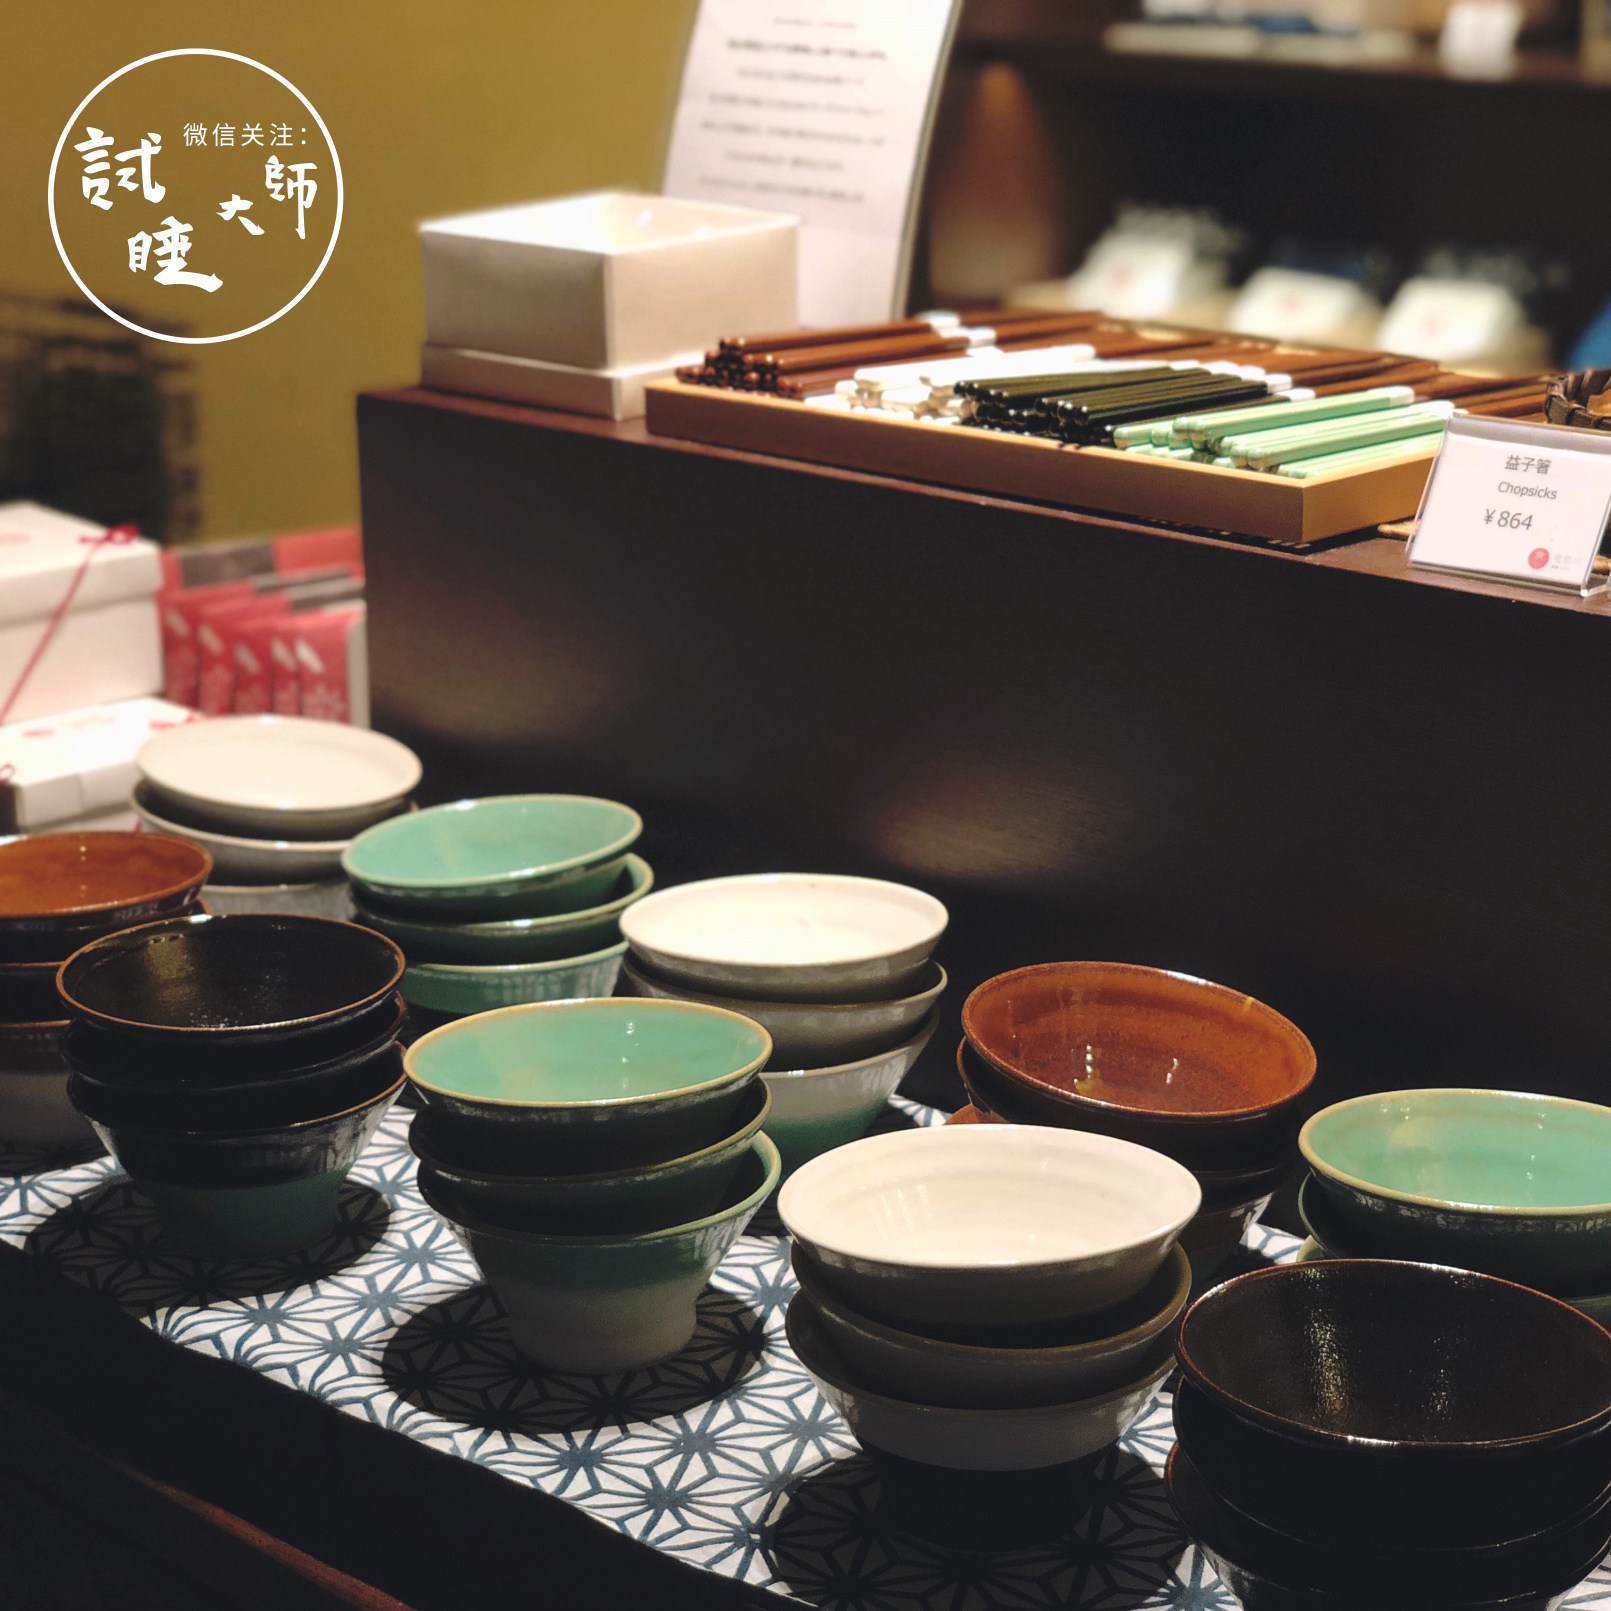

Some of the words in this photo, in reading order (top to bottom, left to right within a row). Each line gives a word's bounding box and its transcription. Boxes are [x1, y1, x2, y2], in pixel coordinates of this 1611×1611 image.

[1504, 454, 1552, 475] 益子箸
[1497, 481, 1558, 500] Chopsicks
[1483, 508, 1533, 531] ¥864
